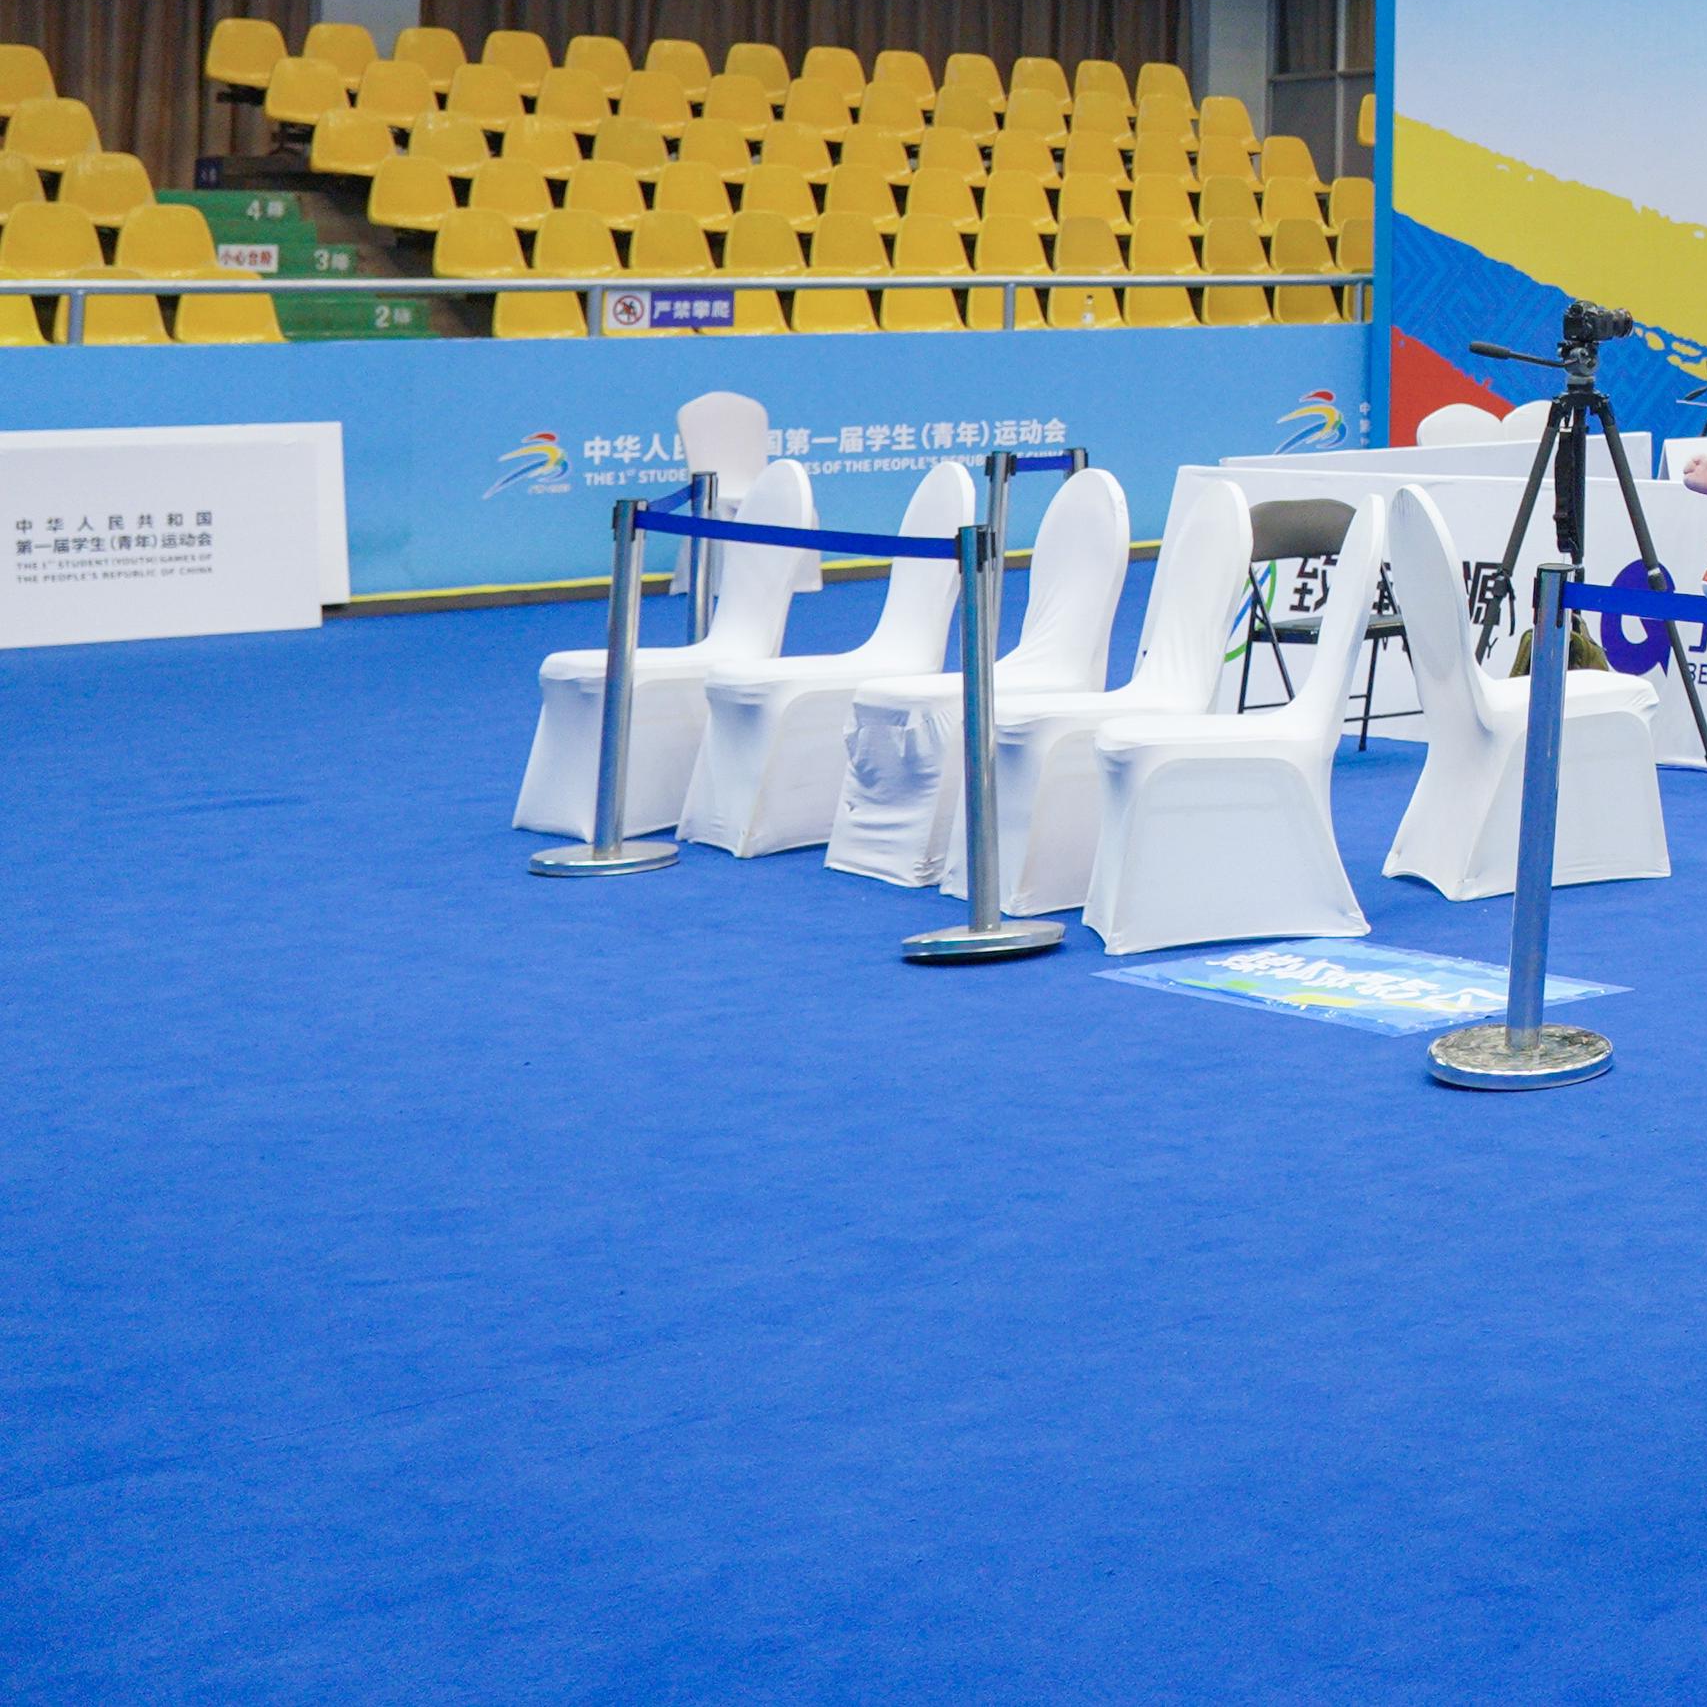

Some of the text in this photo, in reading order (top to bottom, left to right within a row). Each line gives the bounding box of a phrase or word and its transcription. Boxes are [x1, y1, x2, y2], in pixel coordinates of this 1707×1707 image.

[219, 249, 273, 267] 小心台阶
[584, 418, 1066, 464] 中华人国第一届学生(青年)运动会
[585, 472, 615, 486] THE
[638, 468, 689, 483] STUDE
[822, 459, 841, 476] OF
[843, 459, 871, 474] THE
[16, 511, 213, 534] 中华人民共和国
[16, 533, 213, 555] 第一届学生(青年)运动会
[17, 562, 38, 571] THE
[58, 558, 109, 569] STUDENT
[160, 555, 197, 563] GAMES
[199, 553, 212, 562] OF
[17, 566, 213, 584] THE PEOPLE'S REPUBLIC OF CHINA
